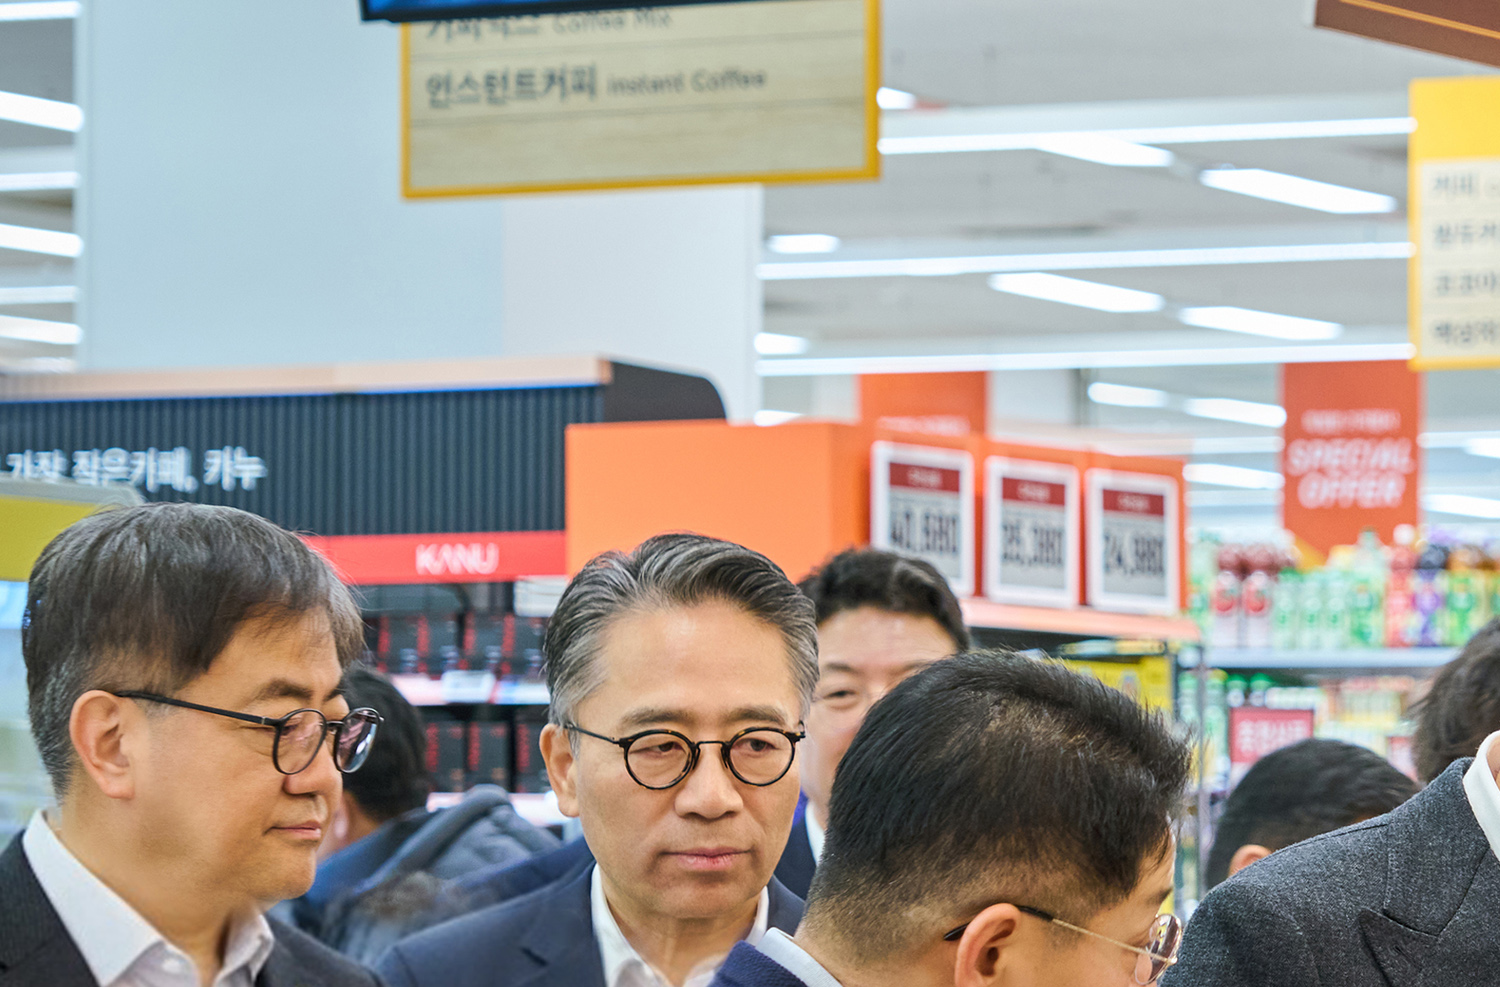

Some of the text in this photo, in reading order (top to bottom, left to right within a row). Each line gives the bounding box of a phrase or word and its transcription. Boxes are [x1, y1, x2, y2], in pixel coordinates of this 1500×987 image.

[426, 63, 597, 109] 인스턴트커피
[691, 69, 767, 94] Coffee
[1432, 173, 1475, 197] 커피
[203, 445, 268, 491] 카누
[1286, 436, 1416, 476] SPECIAL
[1297, 470, 1407, 508] OFFER
[415, 543, 499, 576] KANU
